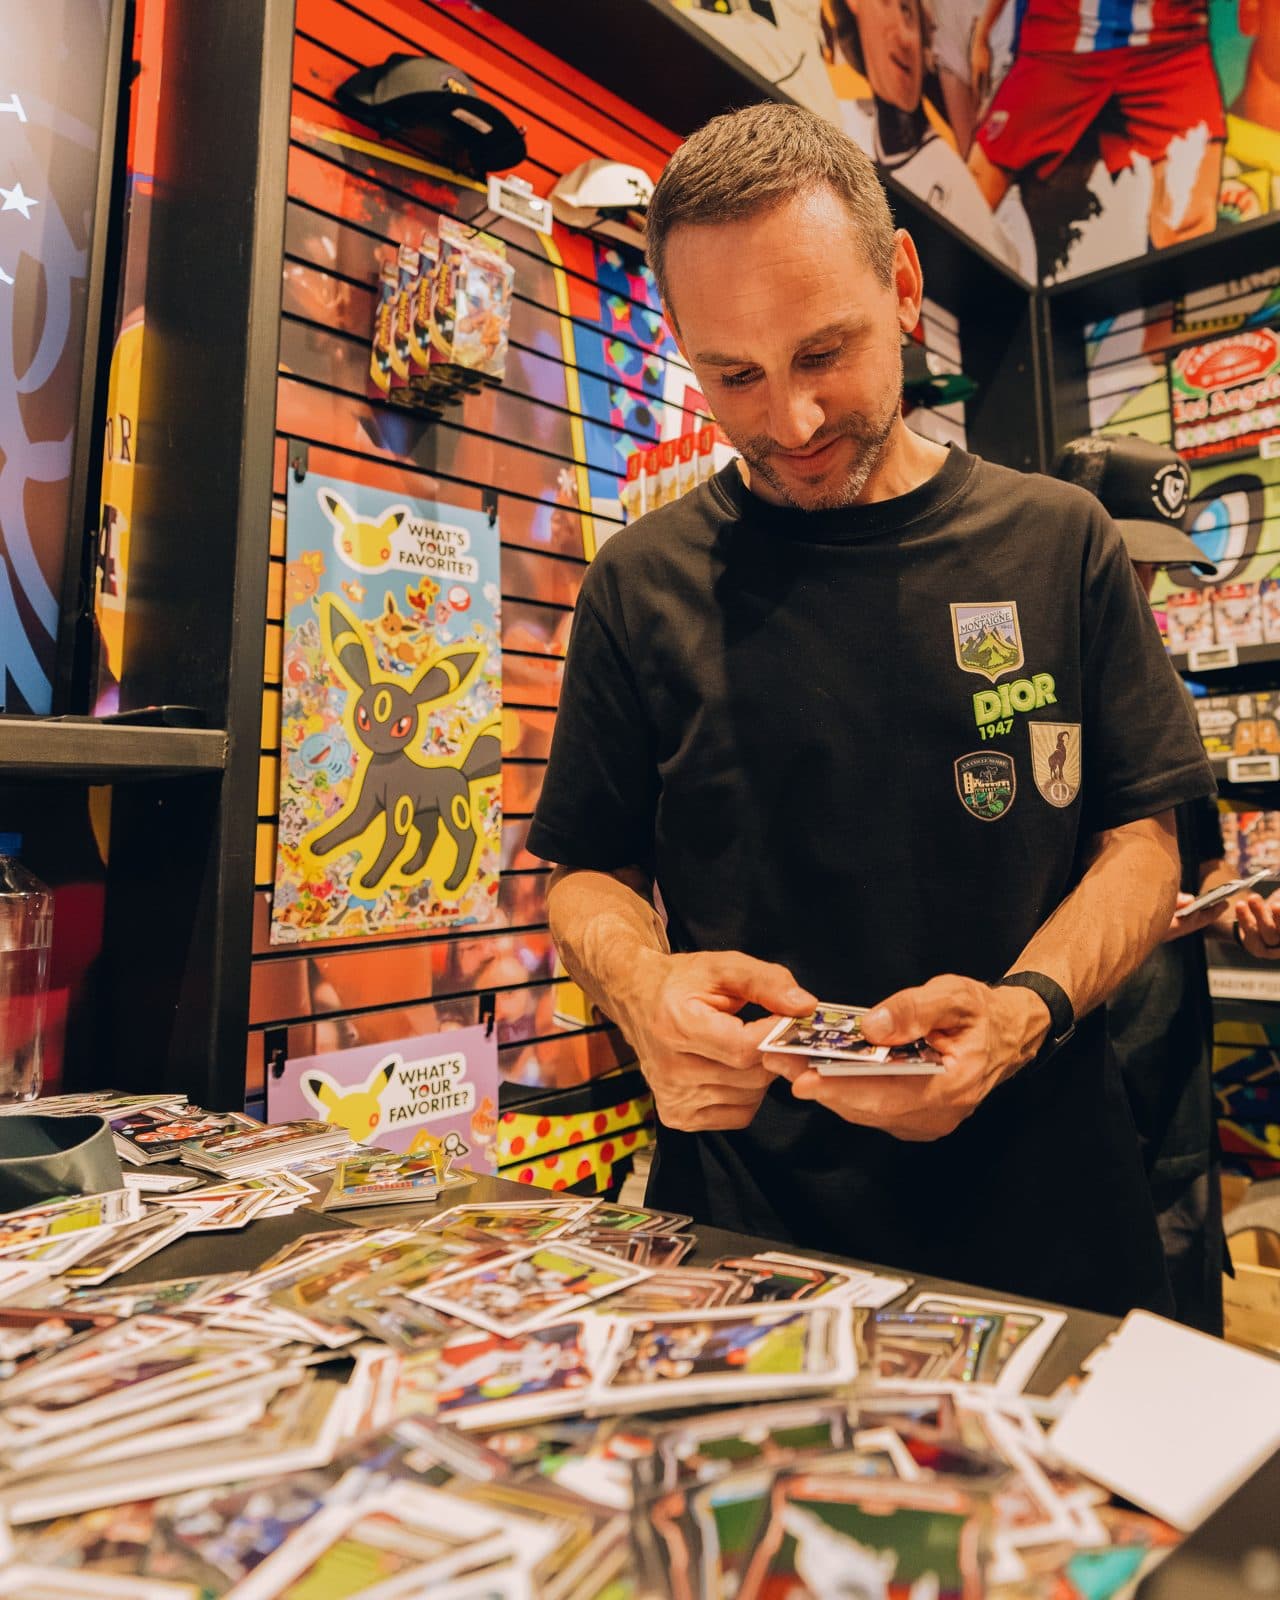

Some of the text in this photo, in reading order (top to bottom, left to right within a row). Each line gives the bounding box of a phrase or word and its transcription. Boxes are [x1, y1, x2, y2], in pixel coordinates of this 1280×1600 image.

[408, 523, 465, 546] WHAT'S
[417, 540, 456, 558] YOUR
[399, 551, 473, 576] FAVORITE?
[960, 612, 1011, 634] MONTAIGNE
[973, 673, 1057, 726] DIOR
[978, 719, 1014, 740] 1947
[399, 1060, 460, 1085] WHAT'S
[409, 1079, 450, 1100] YOUR
[389, 1091, 469, 1123] FAVORITE?
